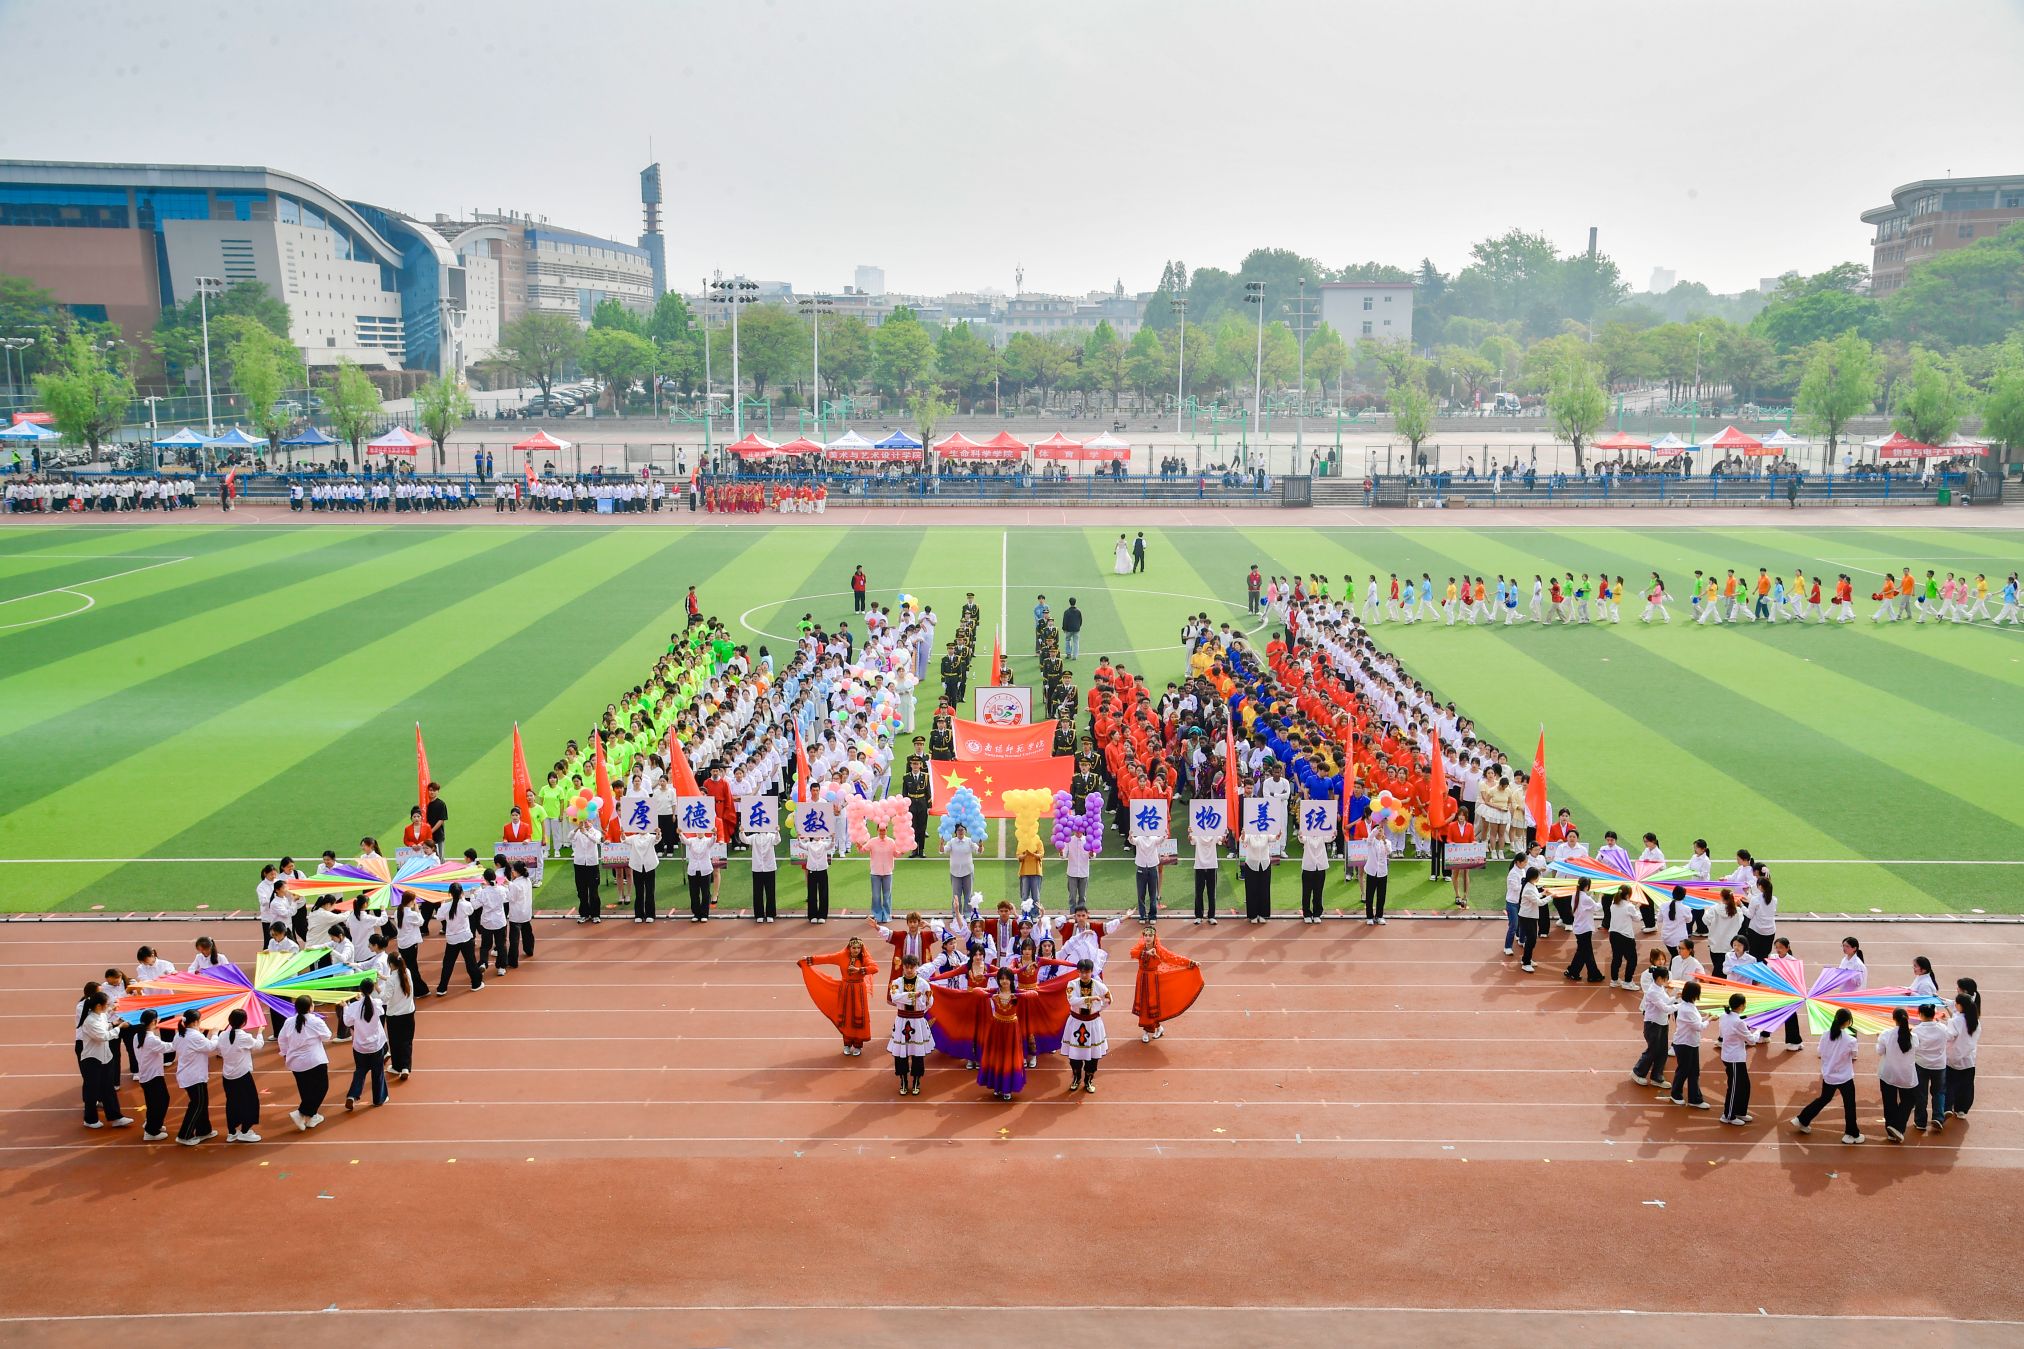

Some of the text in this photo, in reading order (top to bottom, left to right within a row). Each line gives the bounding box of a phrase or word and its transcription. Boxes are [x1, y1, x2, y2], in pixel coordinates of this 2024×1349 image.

[829, 451, 922, 460] 美术与艺术设计学院
[949, 450, 1014, 458] 生命科学学院
[1039, 450, 1124, 459] 体育学院
[1892, 447, 1983, 457] 物理与电子工程学院
[990, 704, 1004, 716] 45
[628, 800, 650, 830] 厚
[683, 801, 711, 830] 德
[749, 801, 770, 827] 乐
[1135, 804, 1163, 831] 格
[1195, 805, 1222, 830] 物
[1249, 801, 1276, 832] 善
